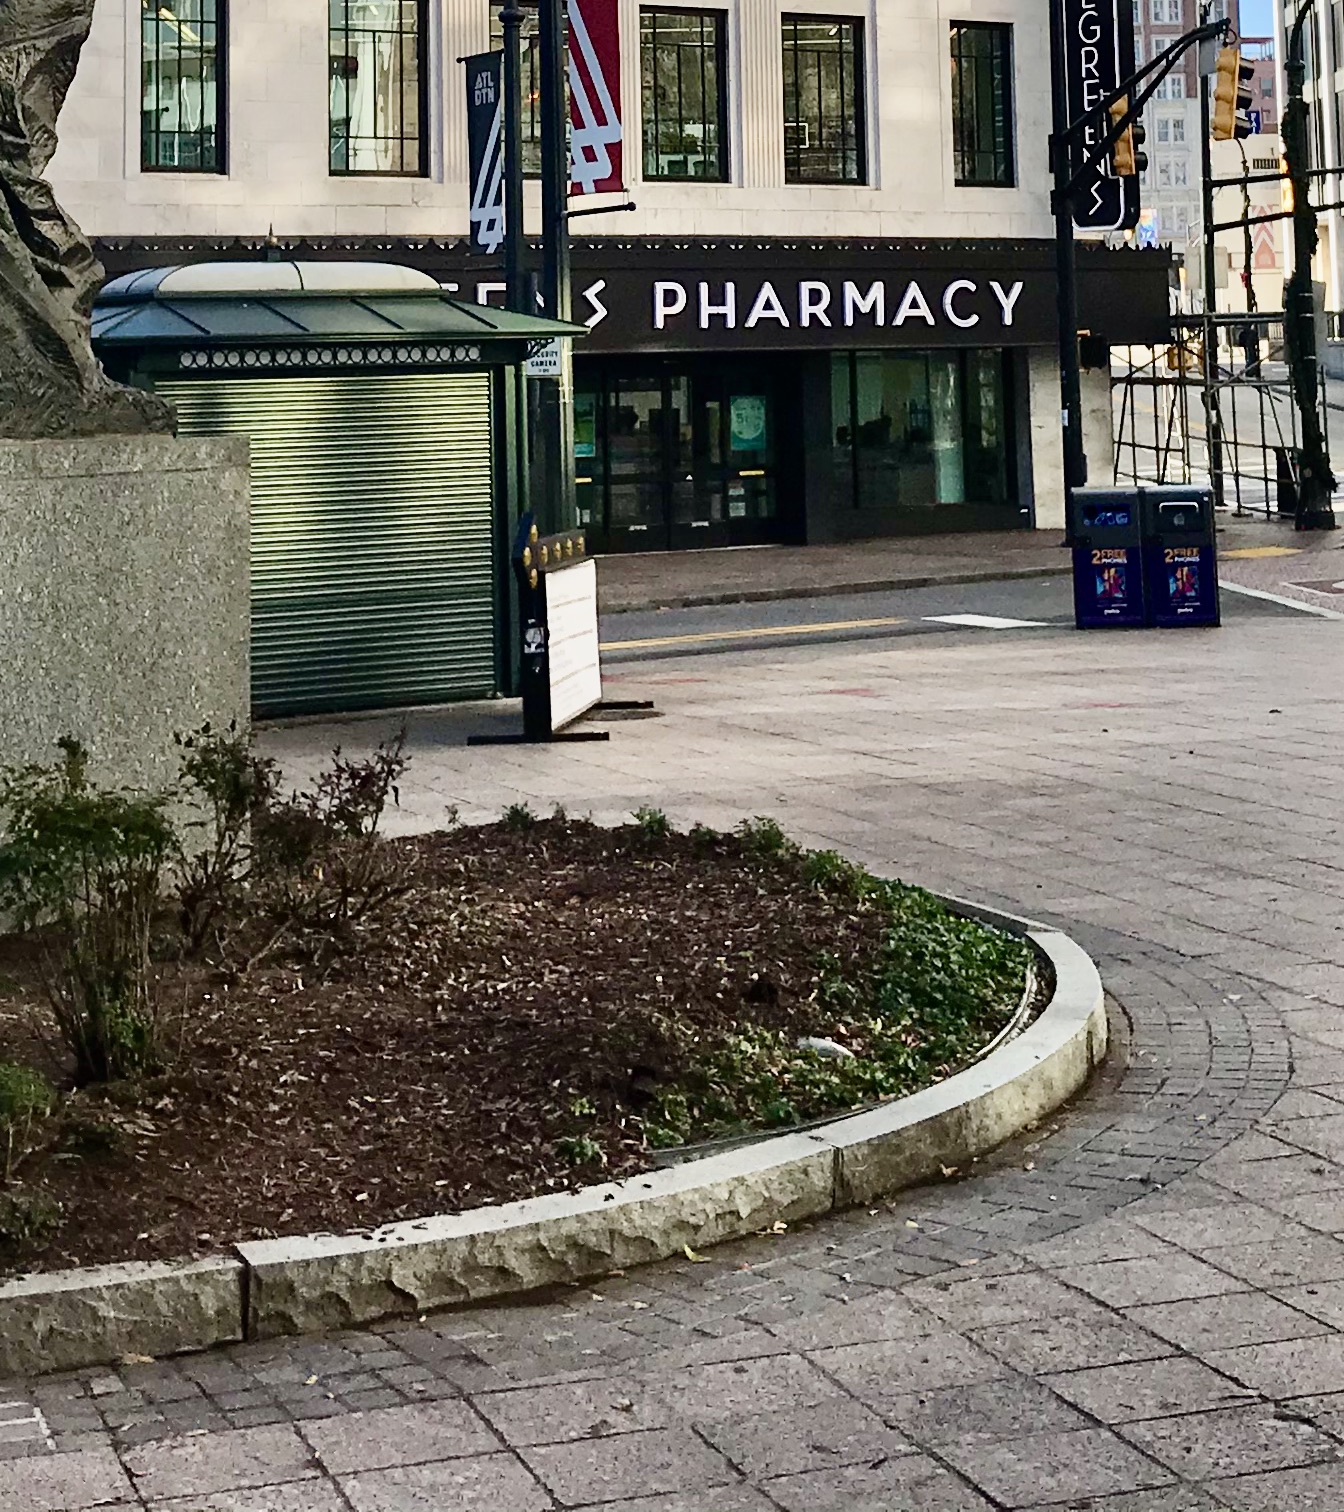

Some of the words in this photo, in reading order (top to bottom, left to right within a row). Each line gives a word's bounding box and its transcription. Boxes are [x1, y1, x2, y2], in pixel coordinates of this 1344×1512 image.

[474, 71, 494, 90] ATL
[474, 87, 495, 106] DTN
[653, 279, 1024, 330] PHARMACY
[1101, 548, 1127, 559] FREE
